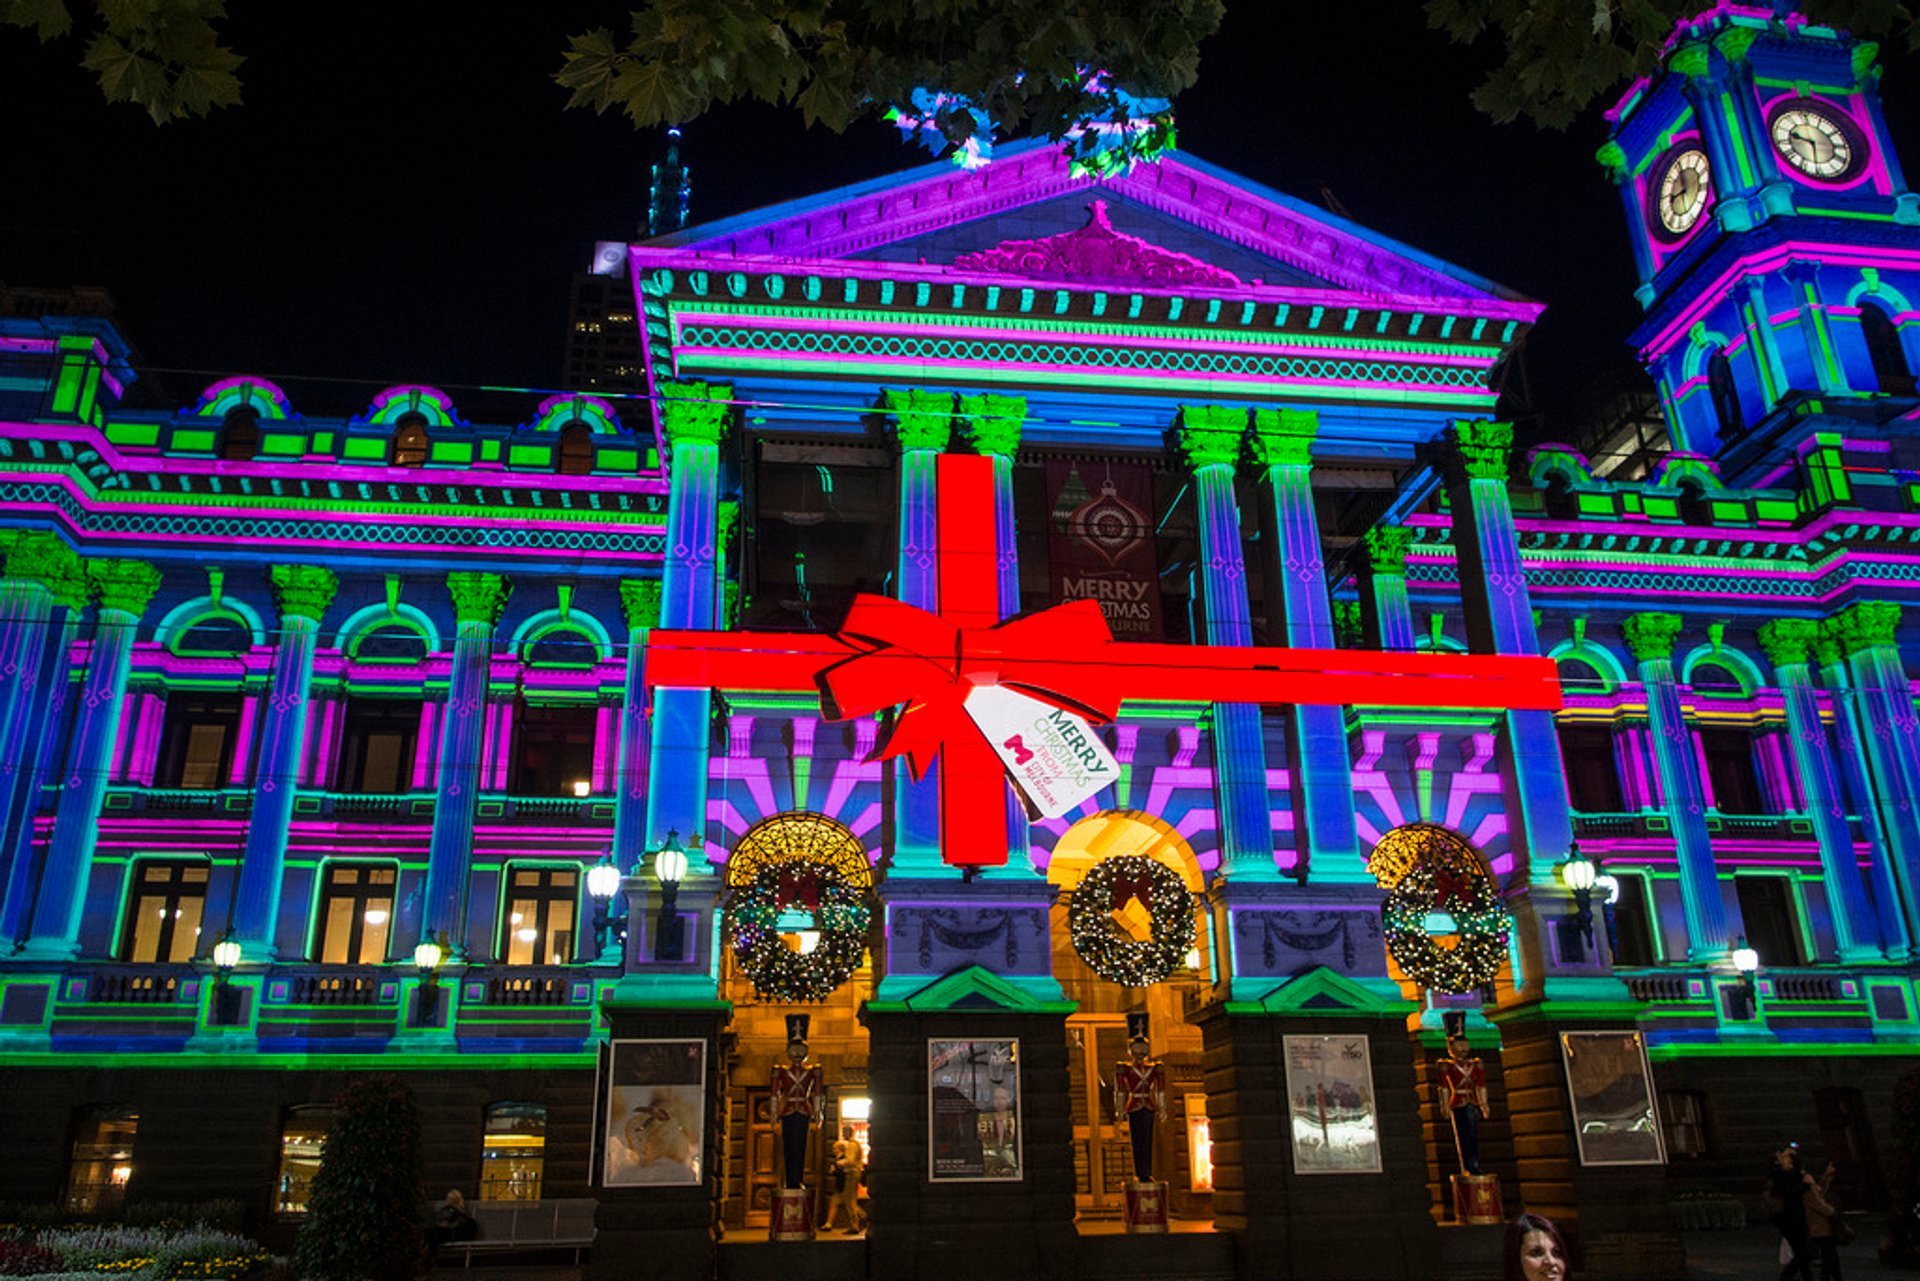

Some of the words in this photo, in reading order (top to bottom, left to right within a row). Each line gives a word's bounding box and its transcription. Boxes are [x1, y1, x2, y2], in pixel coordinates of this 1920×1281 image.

[1063, 576, 1150, 601] MERRY
[1034, 717, 1091, 788] CHRISTMAS
[1037, 746, 1063, 777] FROM
[1048, 709, 1109, 773] MERRY
